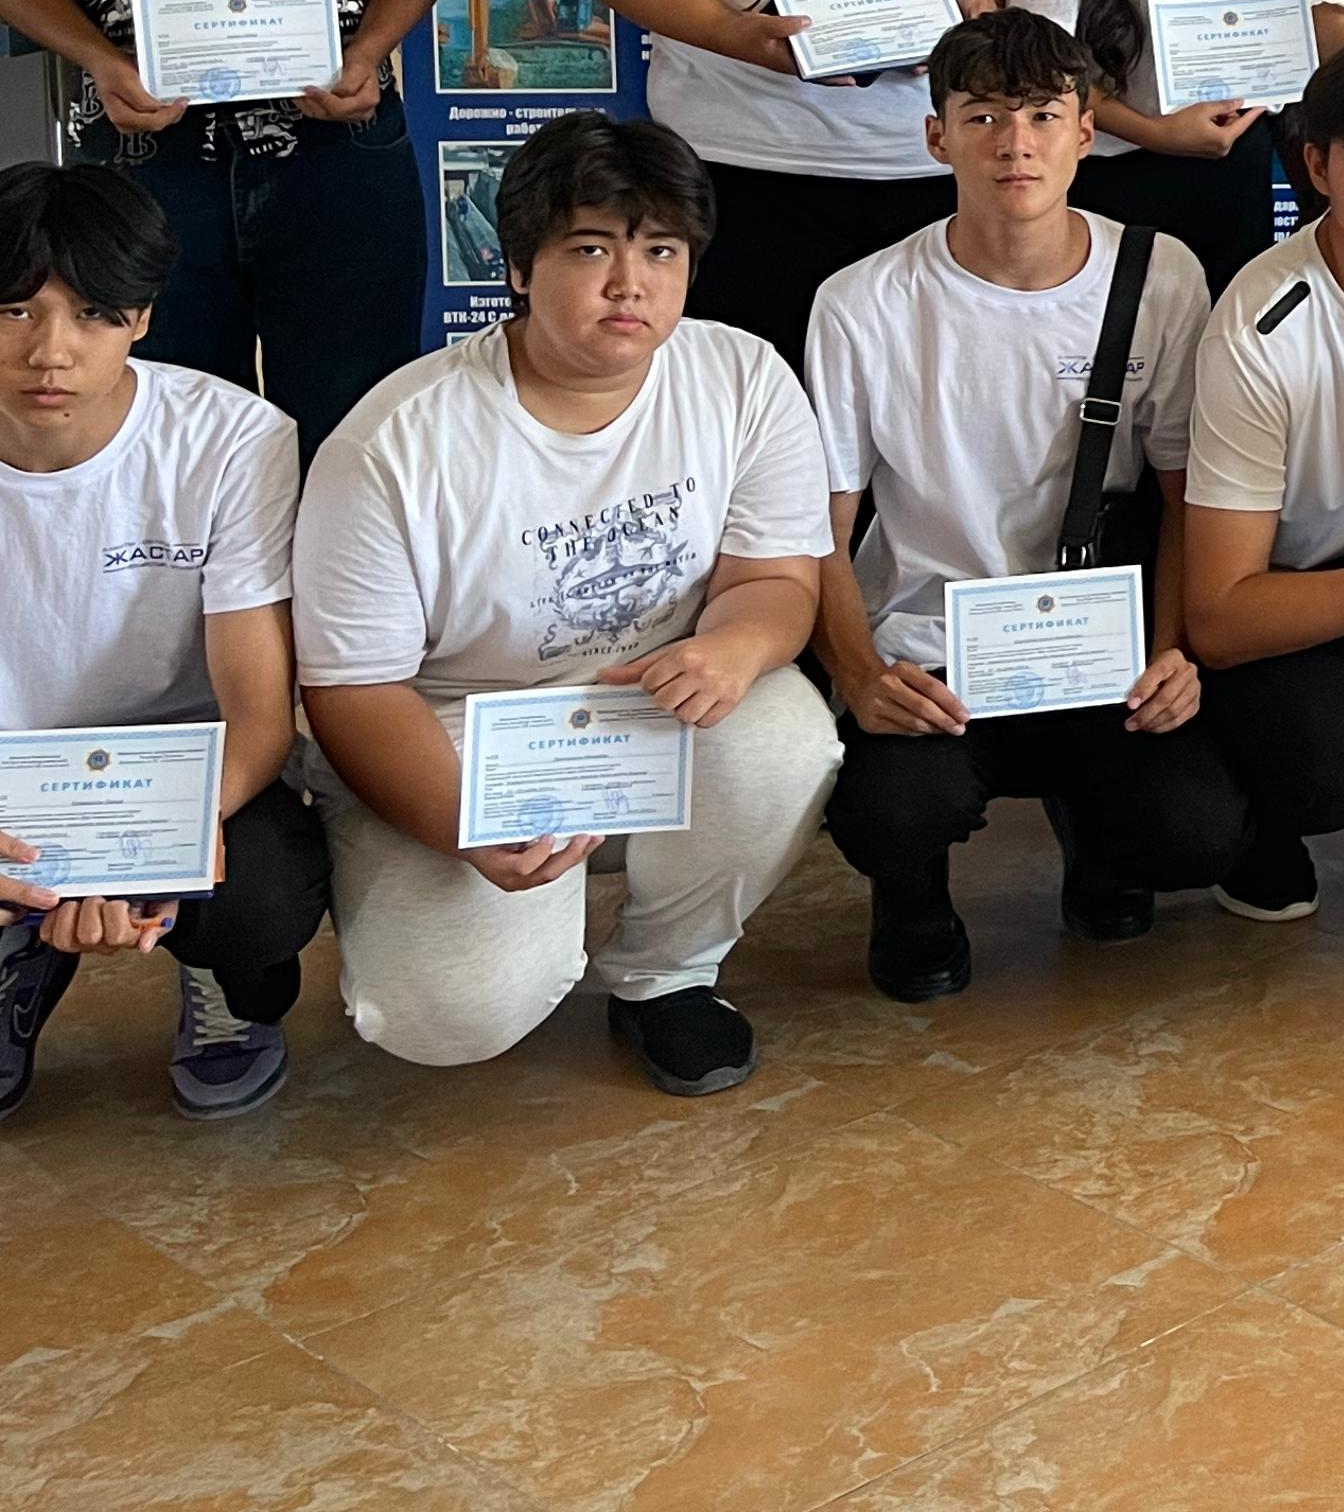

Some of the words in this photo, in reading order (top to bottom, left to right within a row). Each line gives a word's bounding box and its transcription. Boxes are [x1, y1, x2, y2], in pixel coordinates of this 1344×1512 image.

[194, 17, 283, 30] СЕРТИФИКАТ
[1197, 28, 1270, 41] СЕРТИФИКАТ
[521, 492, 654, 546] CONNECTED
[668, 477, 696, 499] TO
[1002, 617, 1089, 633] СЕРТИФИКАТ
[528, 734, 631, 751] СЕРТИФИКАТ
[40, 778, 153, 792] СЕРТИФИКАТ
